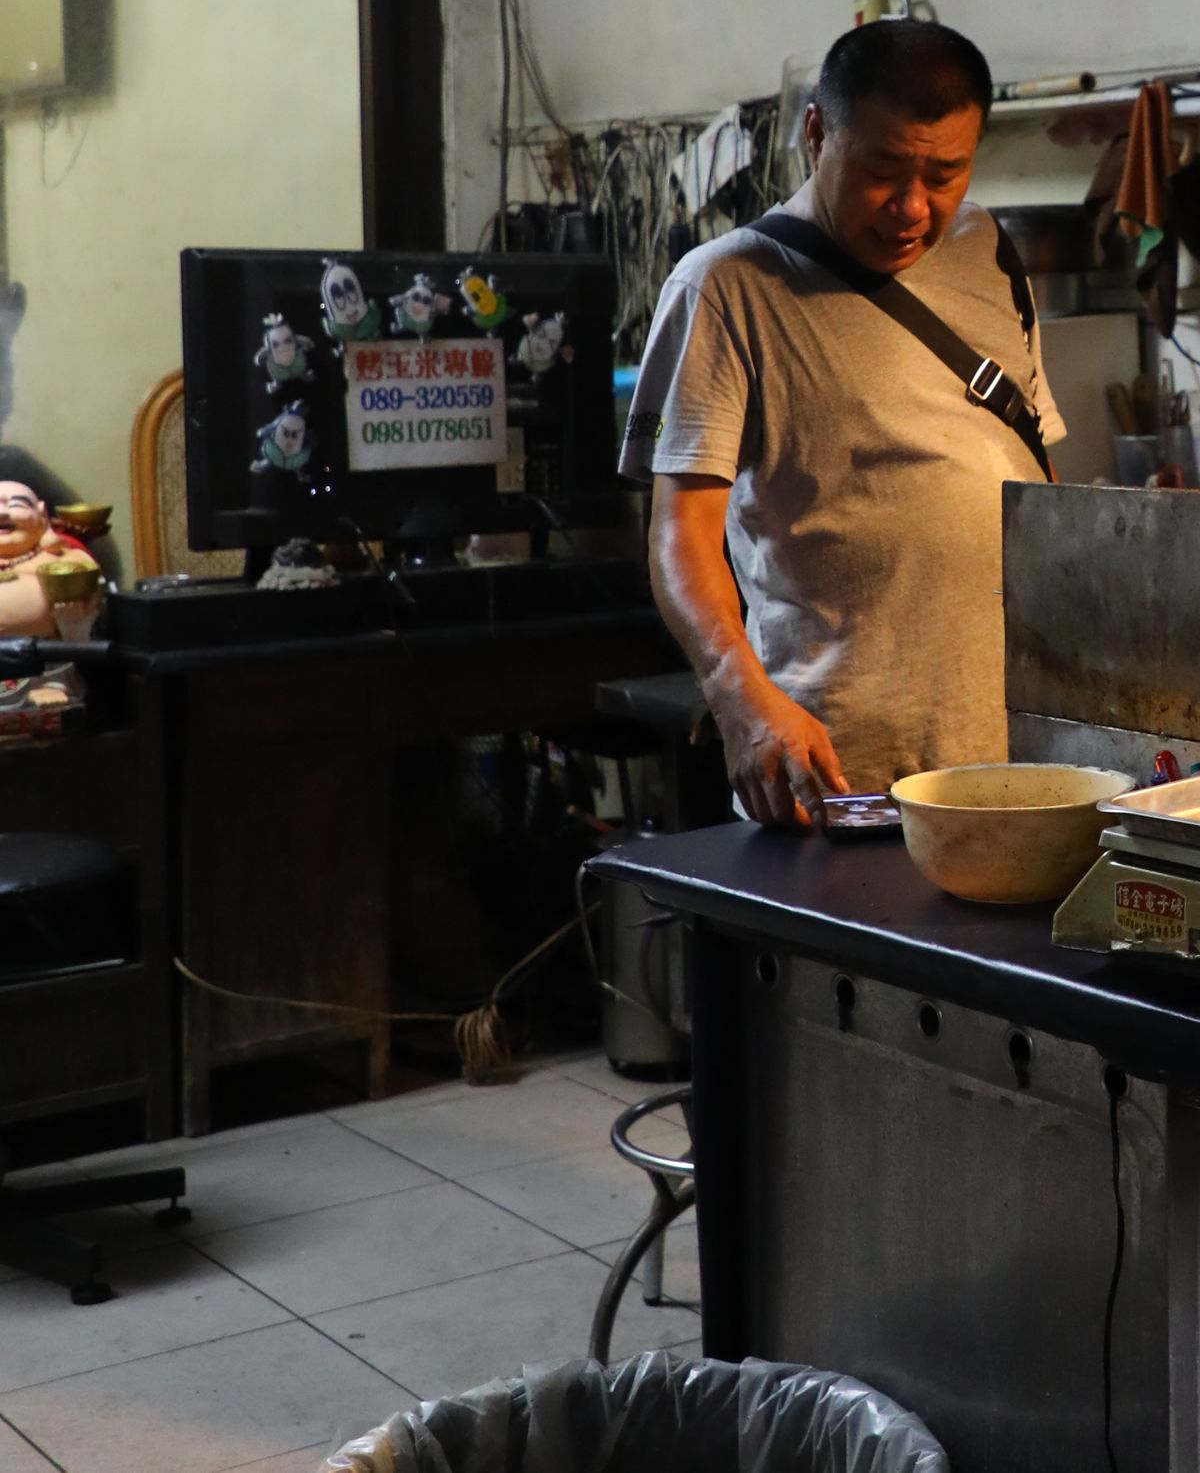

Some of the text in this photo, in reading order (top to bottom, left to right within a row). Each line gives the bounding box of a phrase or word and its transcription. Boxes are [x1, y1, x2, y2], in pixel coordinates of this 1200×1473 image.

[356, 349, 496, 381] 烤玉米專線
[361, 384, 493, 411] 089-320559
[362, 417, 493, 444] 0981078651
